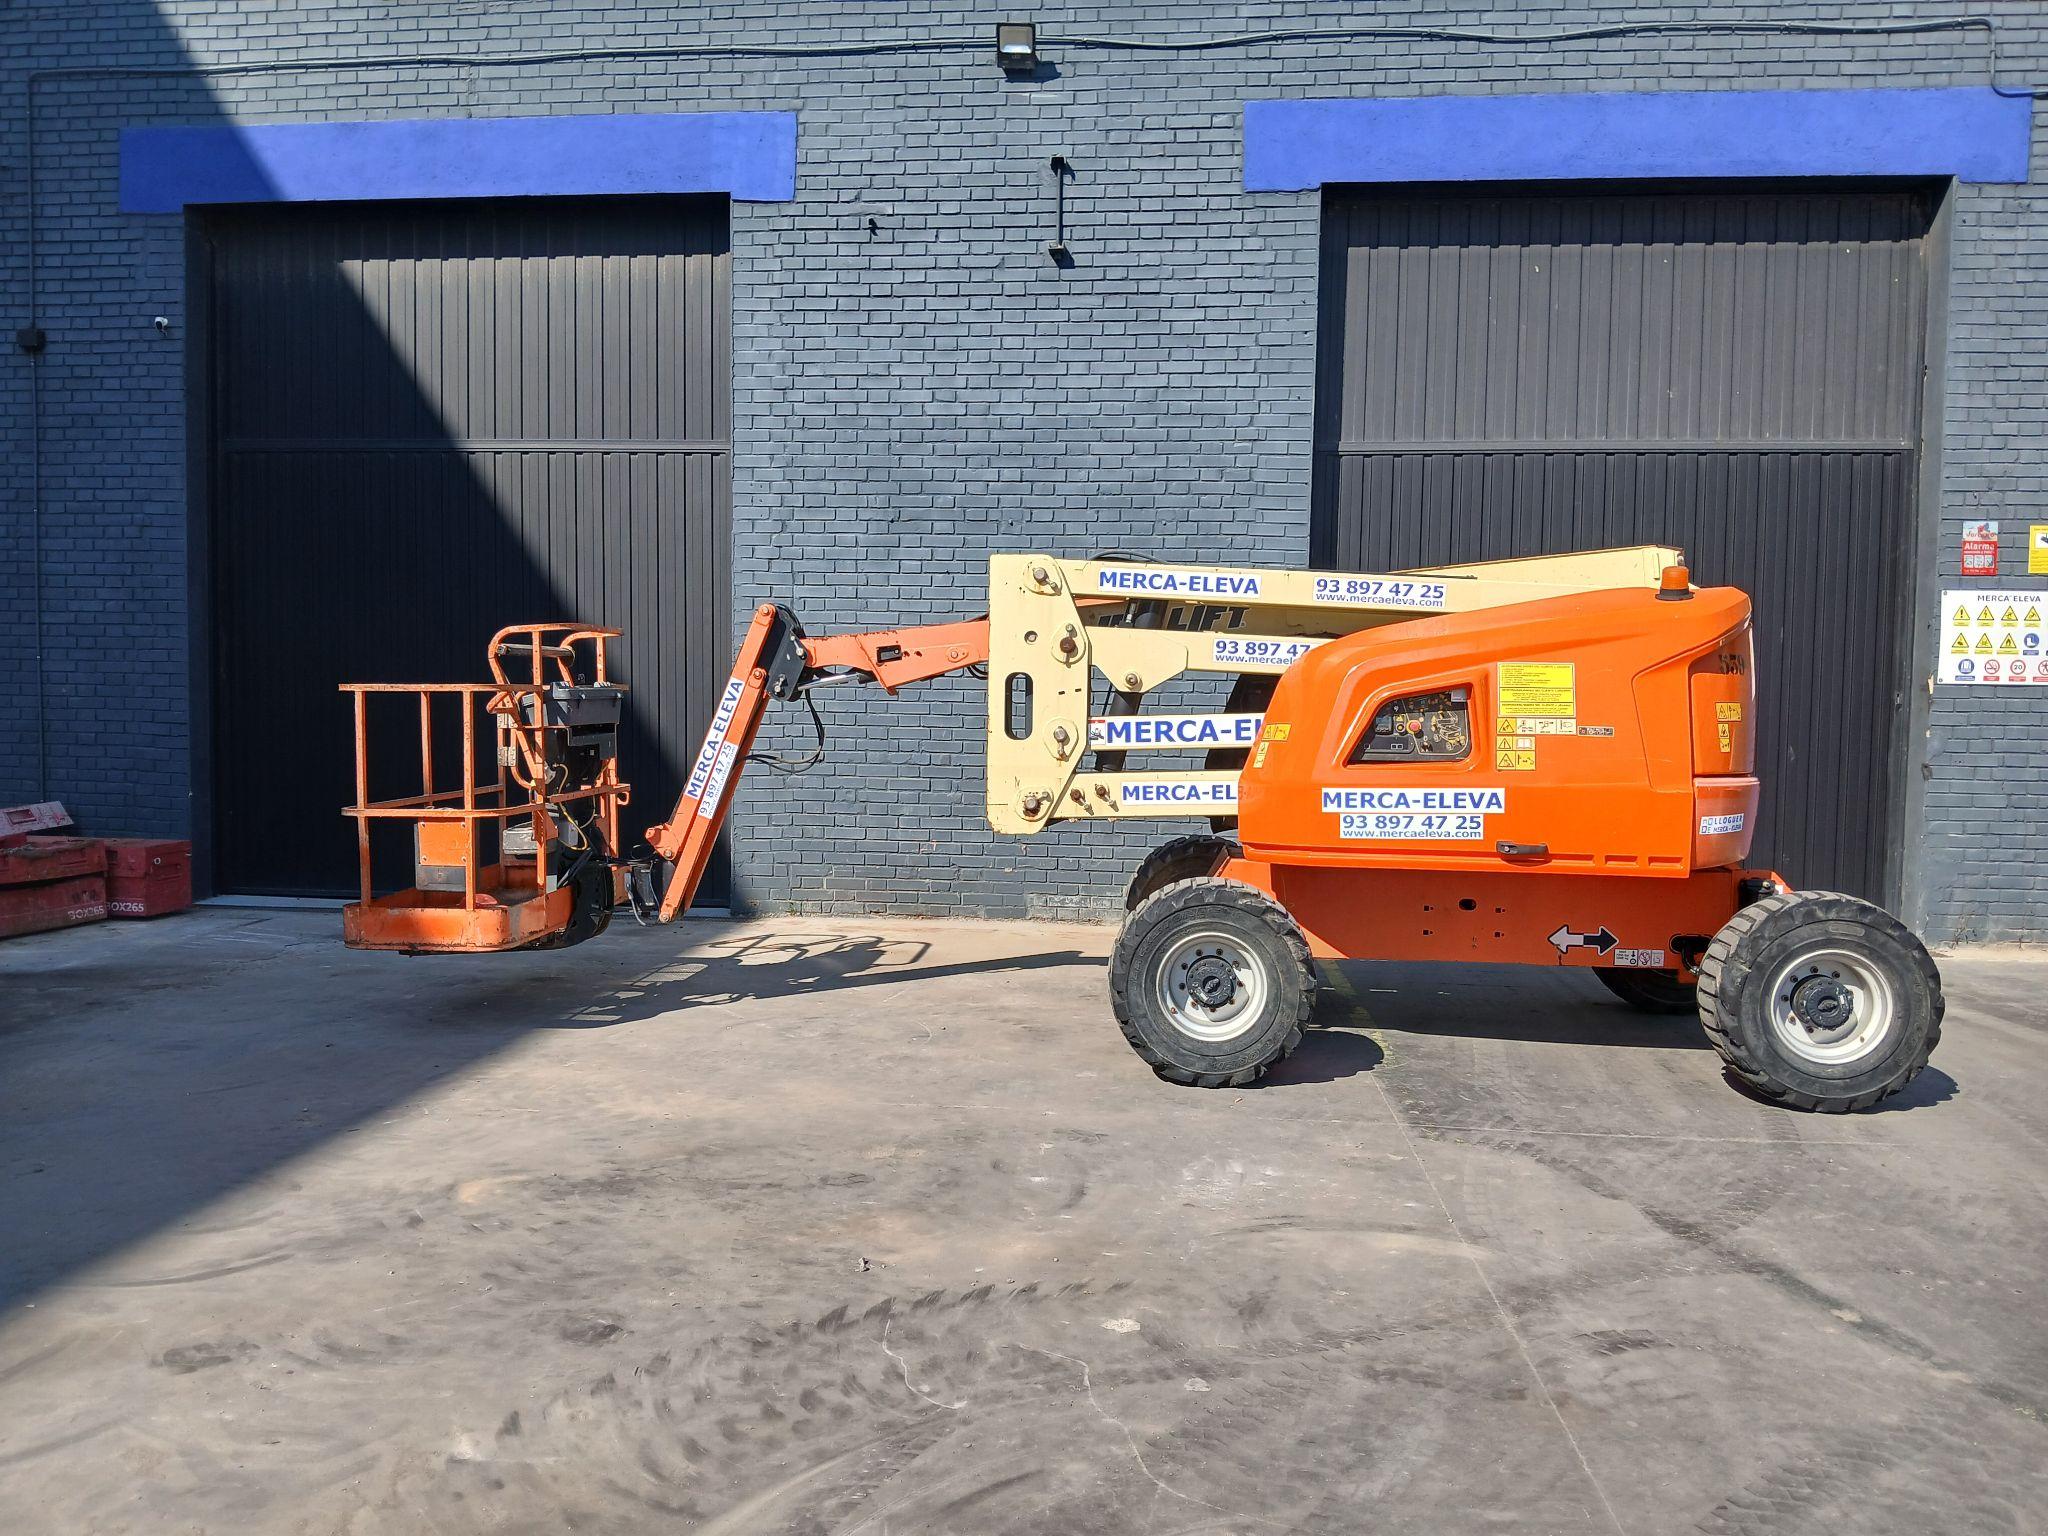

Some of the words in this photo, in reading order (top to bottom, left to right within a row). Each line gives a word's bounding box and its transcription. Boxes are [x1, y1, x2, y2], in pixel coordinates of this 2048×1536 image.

[1964, 542, 1994, 550] Alarma
[1099, 571, 1259, 595] MERCA-ELEVA
[1316, 578, 1340, 593] 93
[1346, 580, 1384, 595] 897
[1388, 583, 1414, 597] 47
[1420, 584, 1445, 599] 25
[1316, 592, 1443, 608] www.mercaeleva.com
[1215, 640, 1239, 654] 93
[1245, 641, 1281, 656] 897
[1286, 644, 1311, 657] 47
[1215, 654, 1294, 665] www.mercael
[687, 681, 743, 798] MERCA-ELEVA
[699, 800, 711, 814] 93
[705, 777, 719, 798] 897
[715, 759, 725, 776] 47
[720, 744, 732, 758] 25
[1122, 784, 1237, 801] MERCA-EL
[1323, 791, 1503, 809] MERCA-ELEVA
[1342, 815, 1368, 829] 93
[1375, 815, 1414, 830] 897
[1421, 816, 1448, 830] 47
[1455, 816, 1482, 830] 25
[1343, 829, 1481, 838] www.mercaeleva.com
